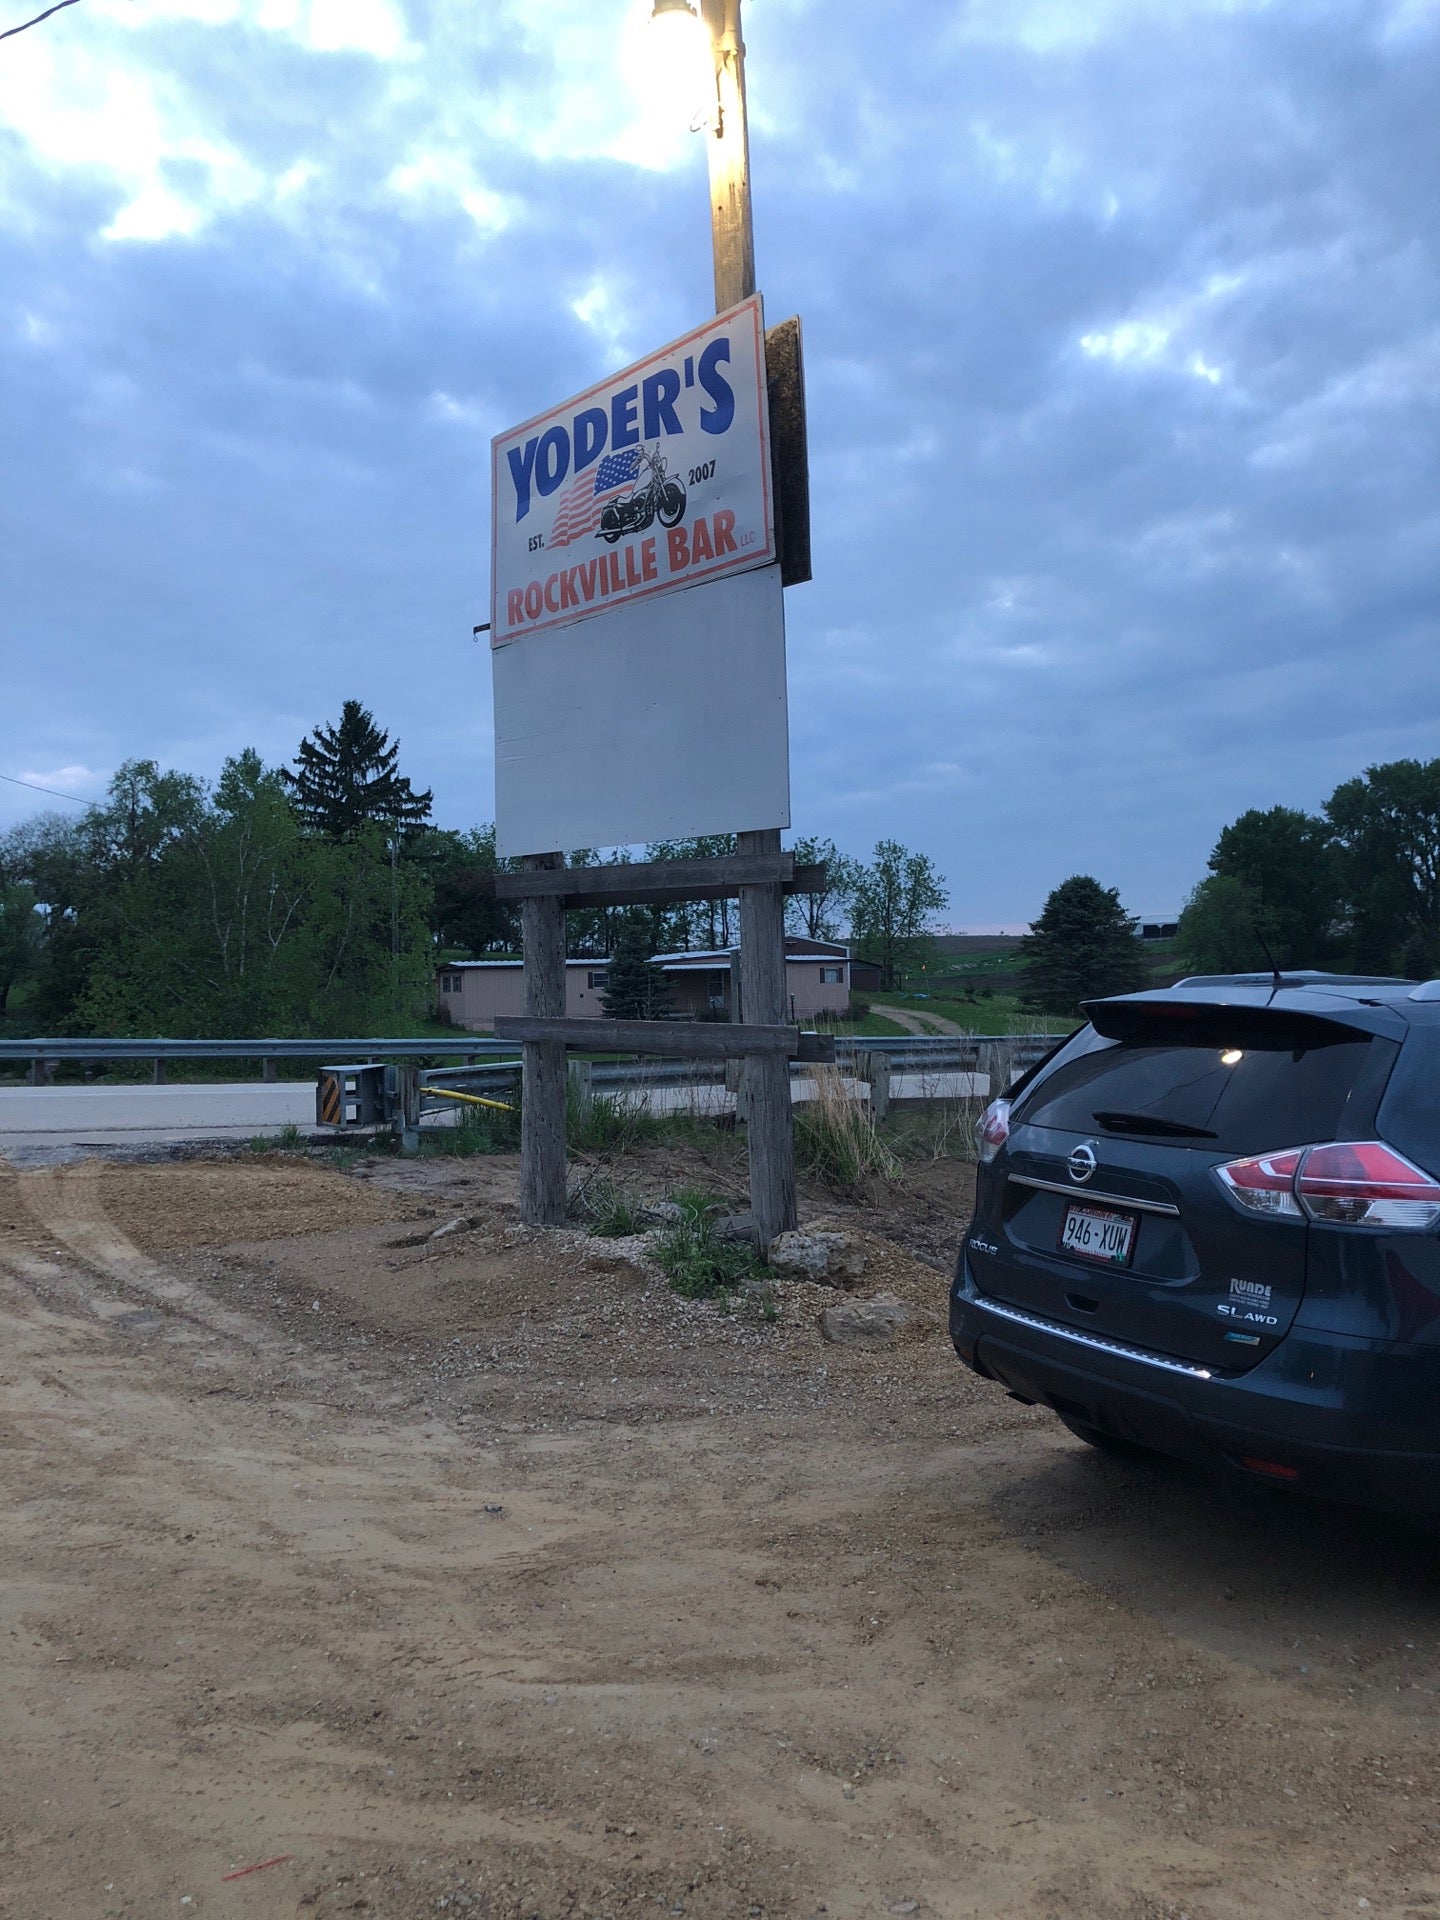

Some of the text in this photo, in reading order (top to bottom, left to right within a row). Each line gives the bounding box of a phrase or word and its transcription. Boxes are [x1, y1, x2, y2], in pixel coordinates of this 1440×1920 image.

[507, 337, 735, 524] YODER'S
[688, 459, 717, 487] 2007
[528, 533, 545, 553] EST.
[507, 509, 755, 626] ROCKVILLE BAR LLC
[969, 1238, 998, 1255] ROGUE
[1067, 1217, 1128, 1254] 946-XUW
[1217, 1304, 1278, 1325] SL AWD
